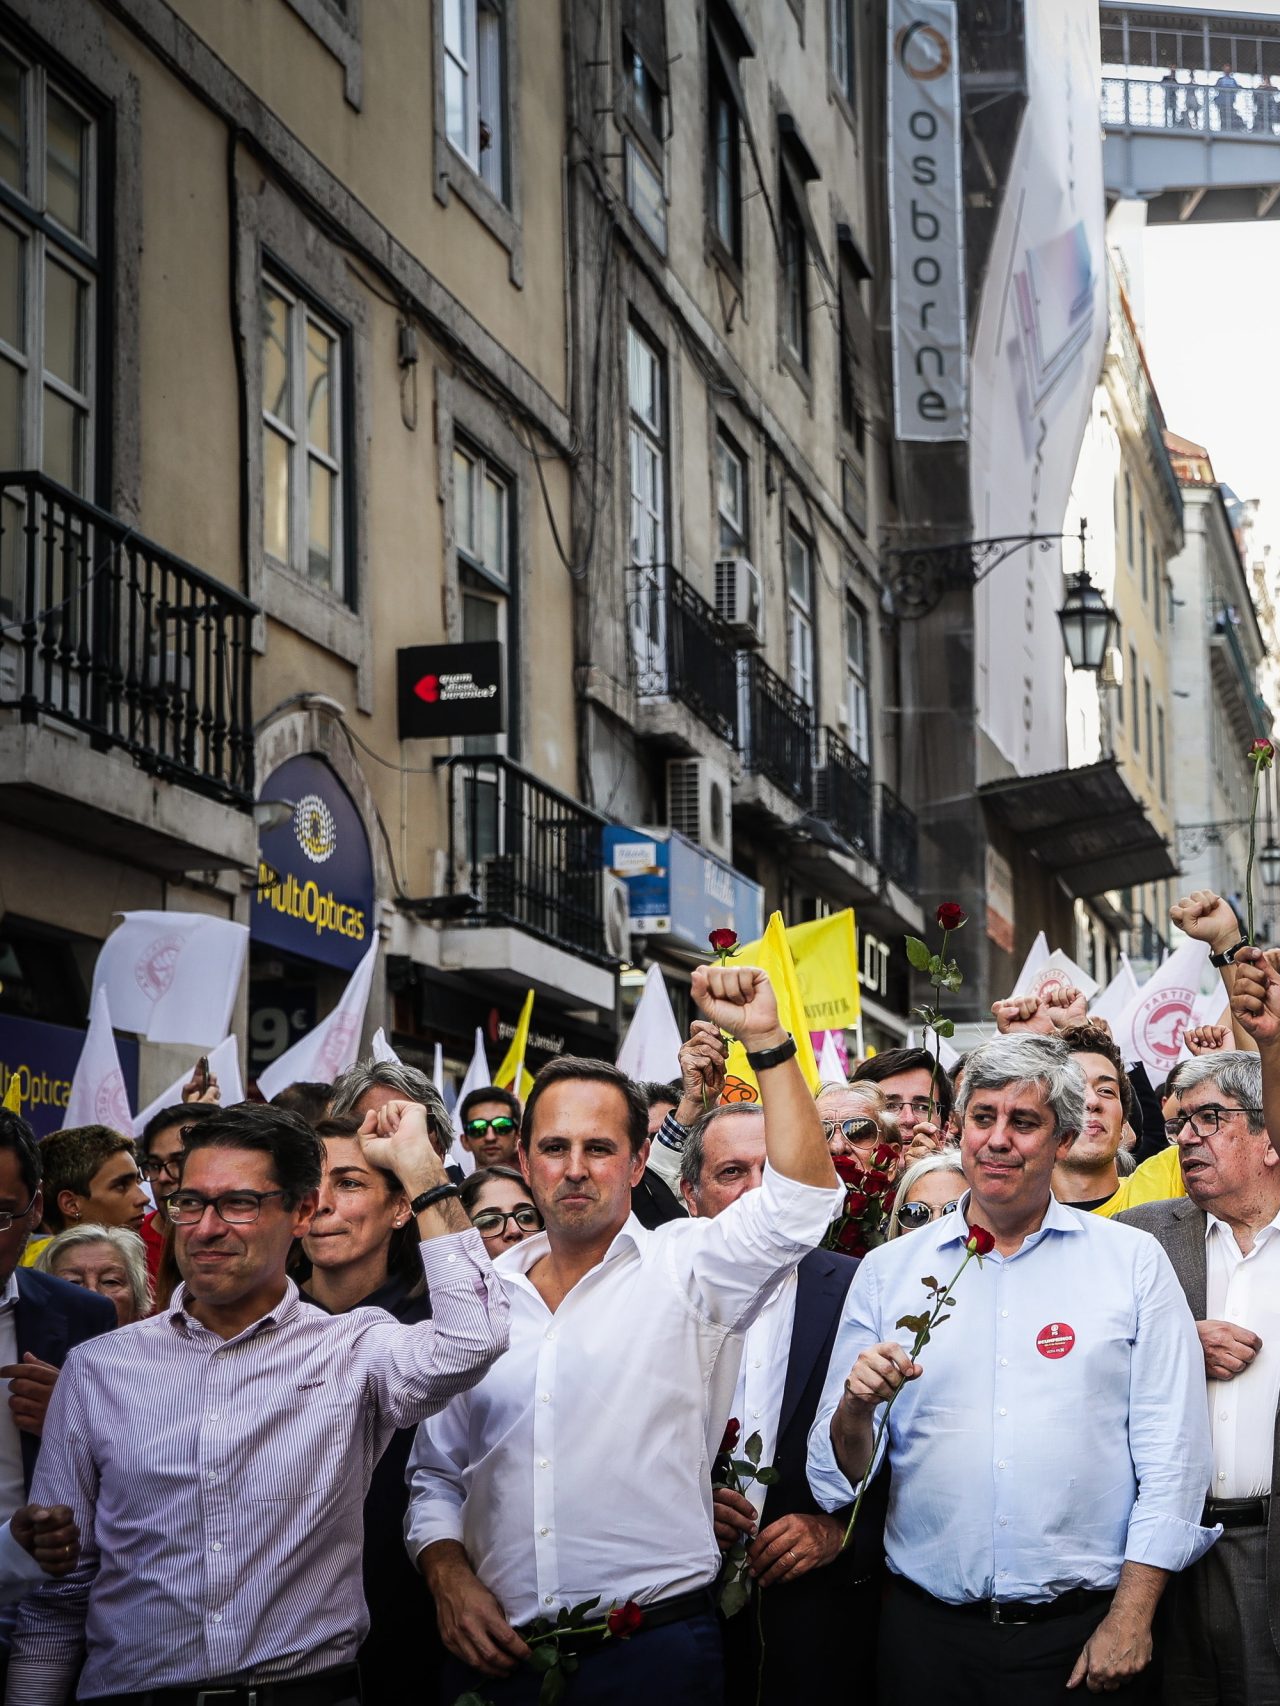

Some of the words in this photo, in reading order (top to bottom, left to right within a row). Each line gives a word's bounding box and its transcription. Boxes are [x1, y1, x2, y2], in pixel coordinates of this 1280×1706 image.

[909, 110, 948, 422] osborne
[257, 862, 365, 940] MultiOpticas
[1144, 991, 1194, 1011] PARTID
